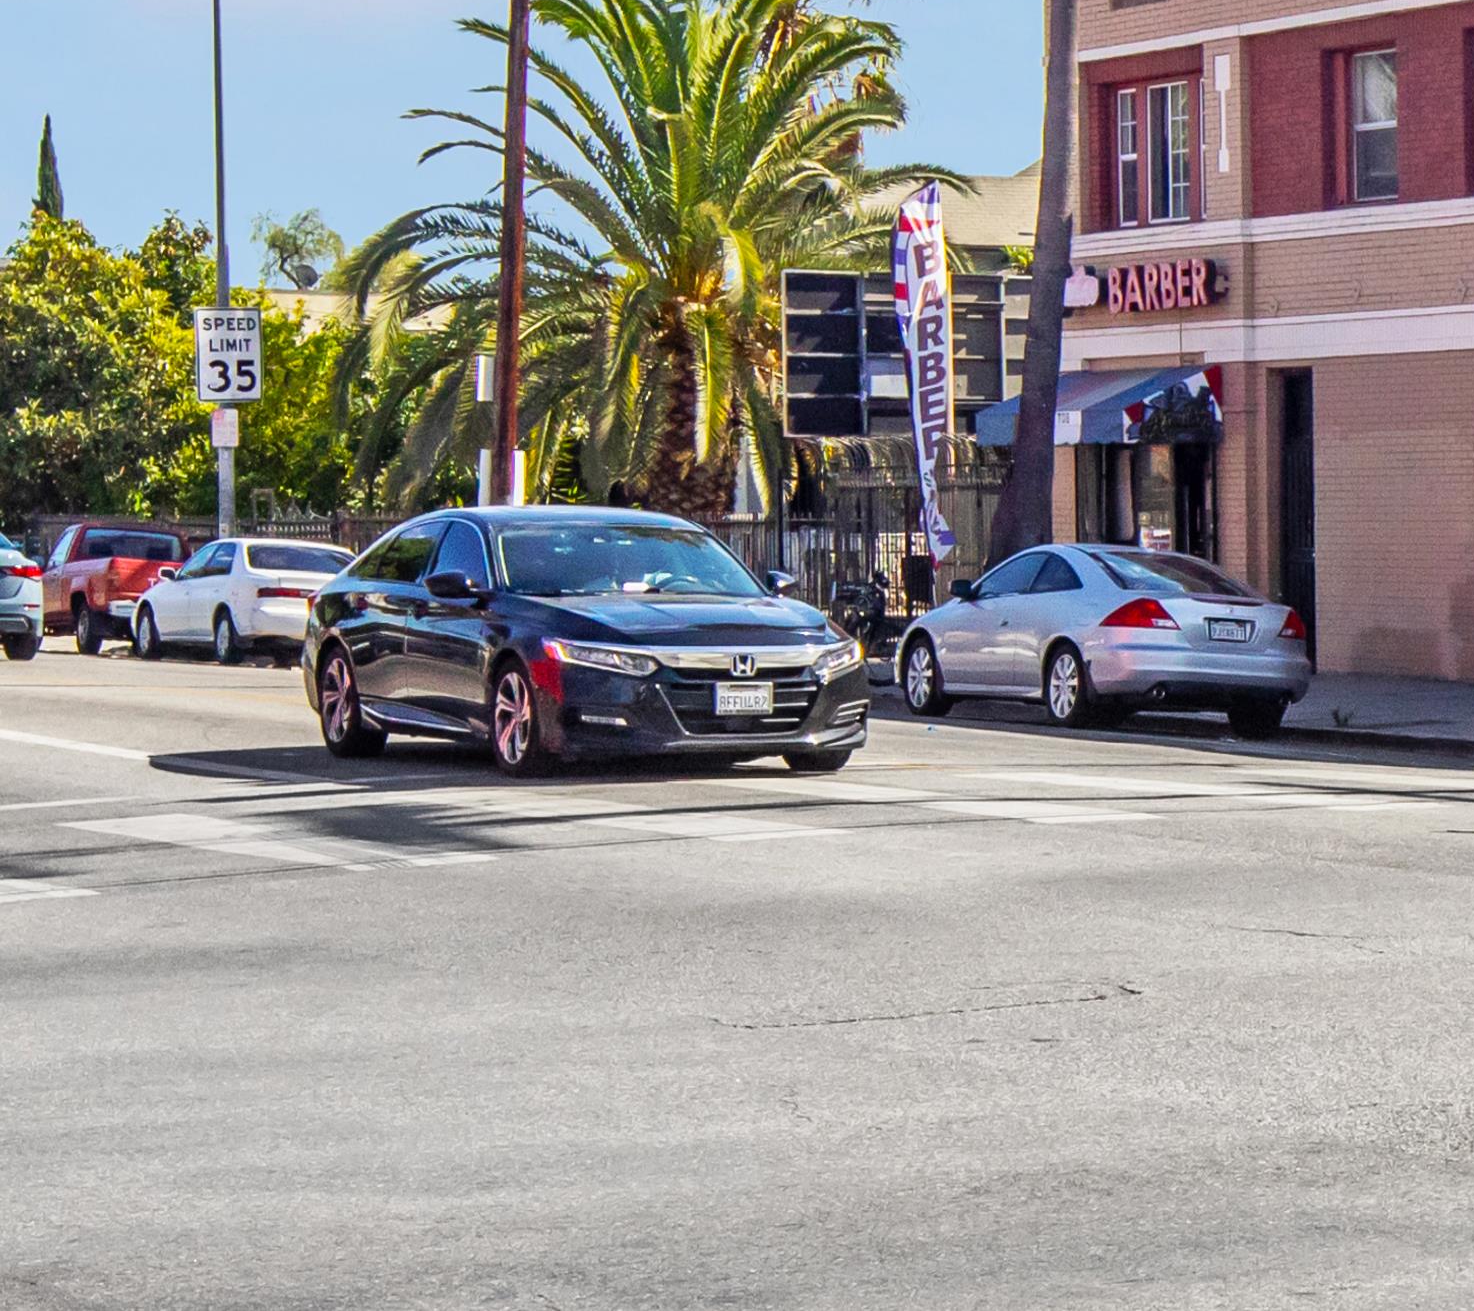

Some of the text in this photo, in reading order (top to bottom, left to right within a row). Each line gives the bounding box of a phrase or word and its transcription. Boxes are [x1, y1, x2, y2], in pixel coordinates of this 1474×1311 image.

[1107, 258, 1208, 314] BARBER
[203, 317, 257, 331] SPEED
[209, 338, 252, 352] LIMIT
[207, 359, 257, 393] 35
